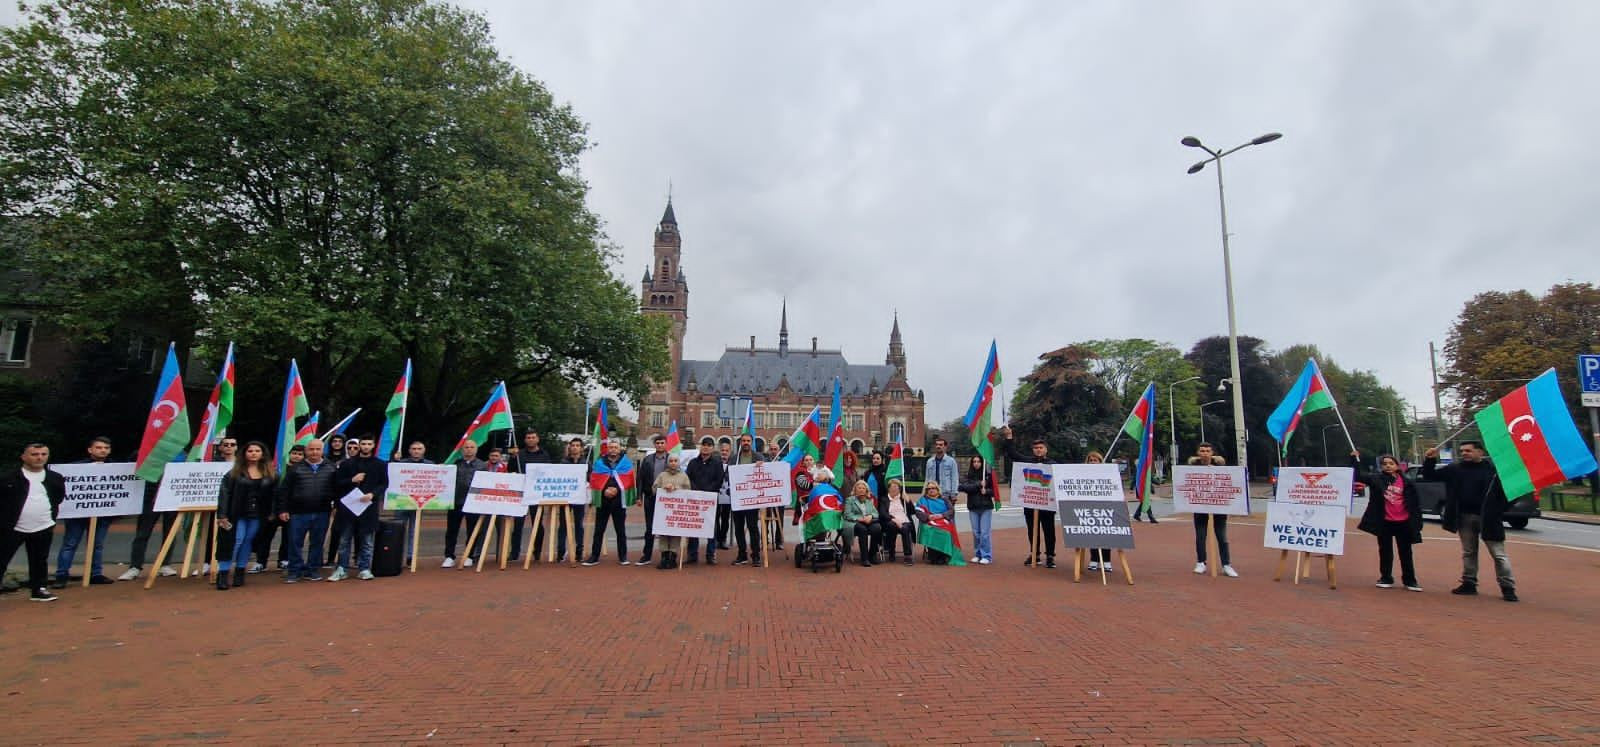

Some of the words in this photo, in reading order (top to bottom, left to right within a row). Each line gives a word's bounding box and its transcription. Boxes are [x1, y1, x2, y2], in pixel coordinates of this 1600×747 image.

[1585, 358, 1599, 377] P
[71, 483, 125, 491] PEACEFUL
[64, 493, 109, 501] WORLD
[76, 501, 118, 509] FUTURE
[1073, 508, 1091, 517] WE
[1092, 508, 1114, 517] SAY
[1078, 517, 1096, 526] NO
[1097, 517, 1113, 525] TO
[1064, 526, 1131, 535] TERRORISM!
[1272, 524, 1292, 534] WE
[1296, 526, 1338, 538] WANT
[1279, 535, 1329, 548] PEACE!
